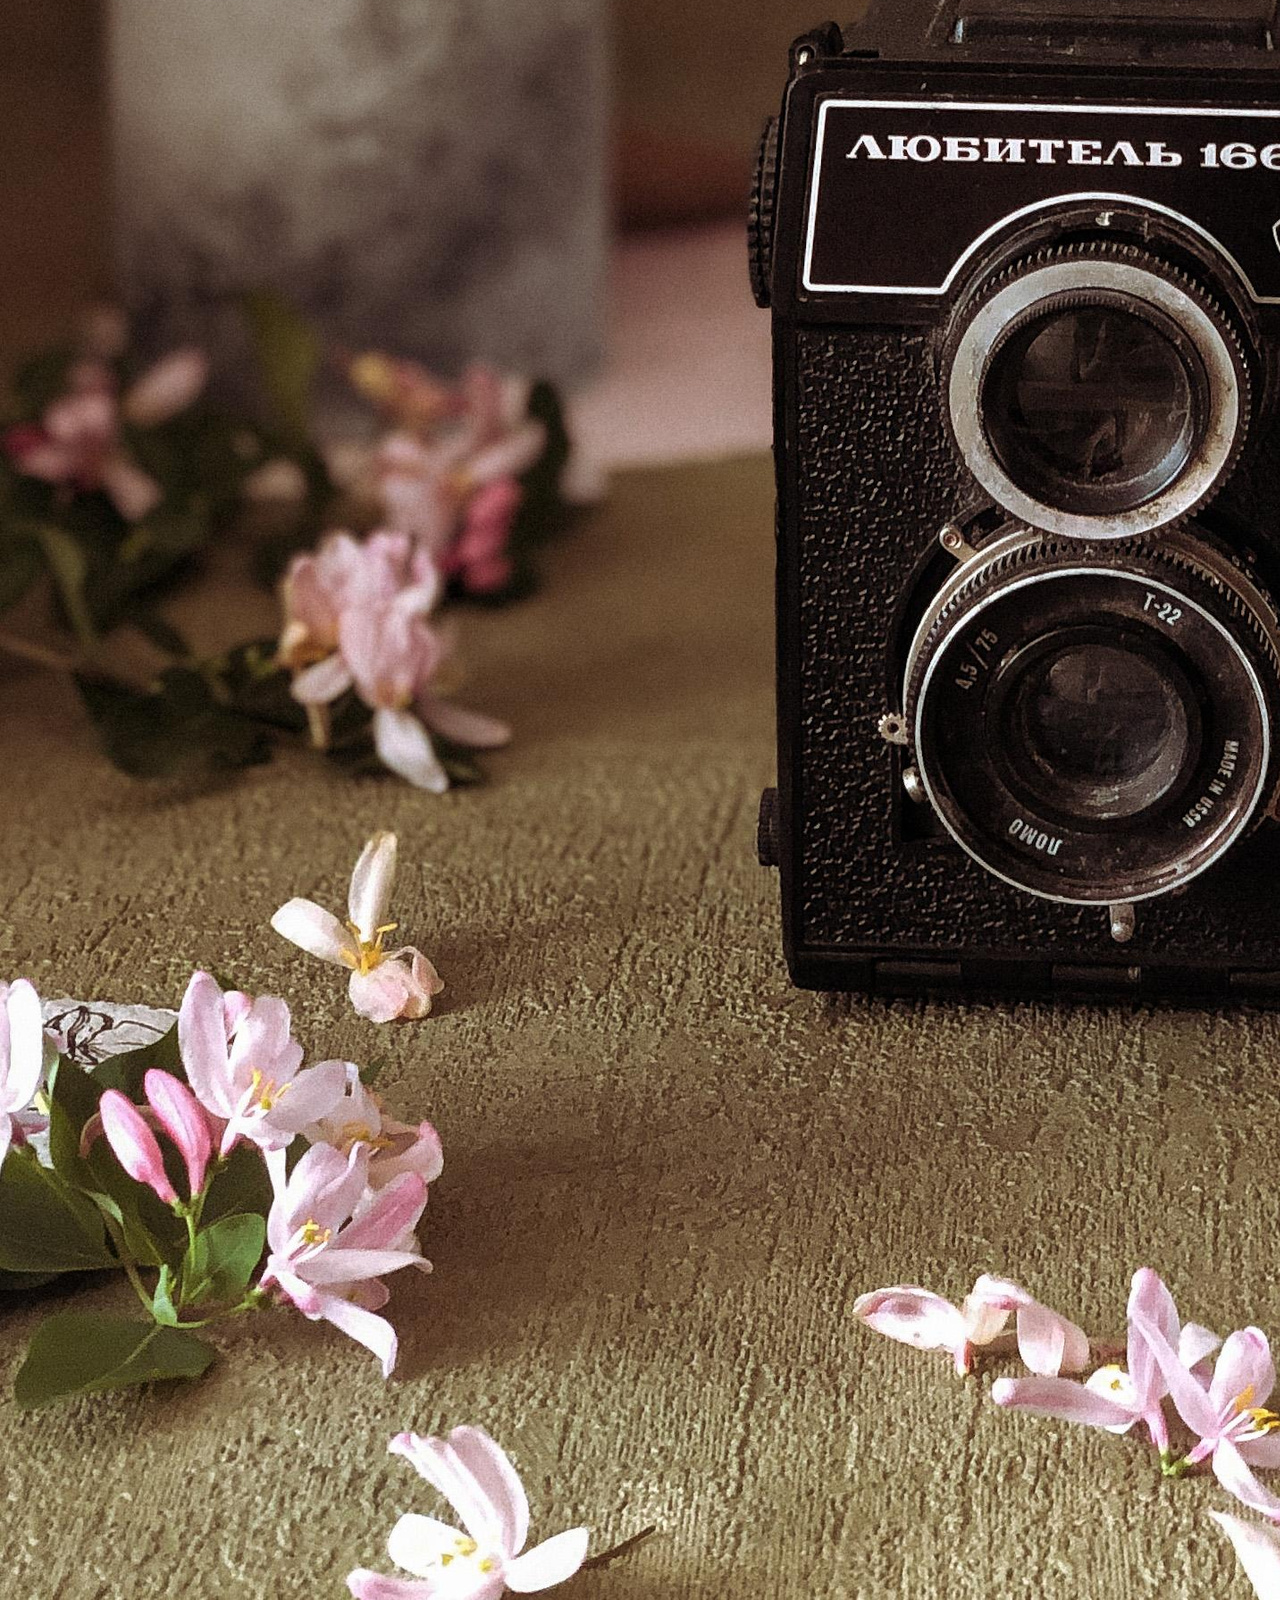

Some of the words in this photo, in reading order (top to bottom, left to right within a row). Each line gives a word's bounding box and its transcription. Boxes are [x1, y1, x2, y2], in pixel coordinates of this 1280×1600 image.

[845, 134, 1183, 167] ЛЮБИТЕЛЬ
[1217, 740, 1239, 778] MADE
[1208, 778, 1226, 795] IN
[1182, 796, 1215, 828] USSR
[1008, 818, 1063, 856] ЛОМО
